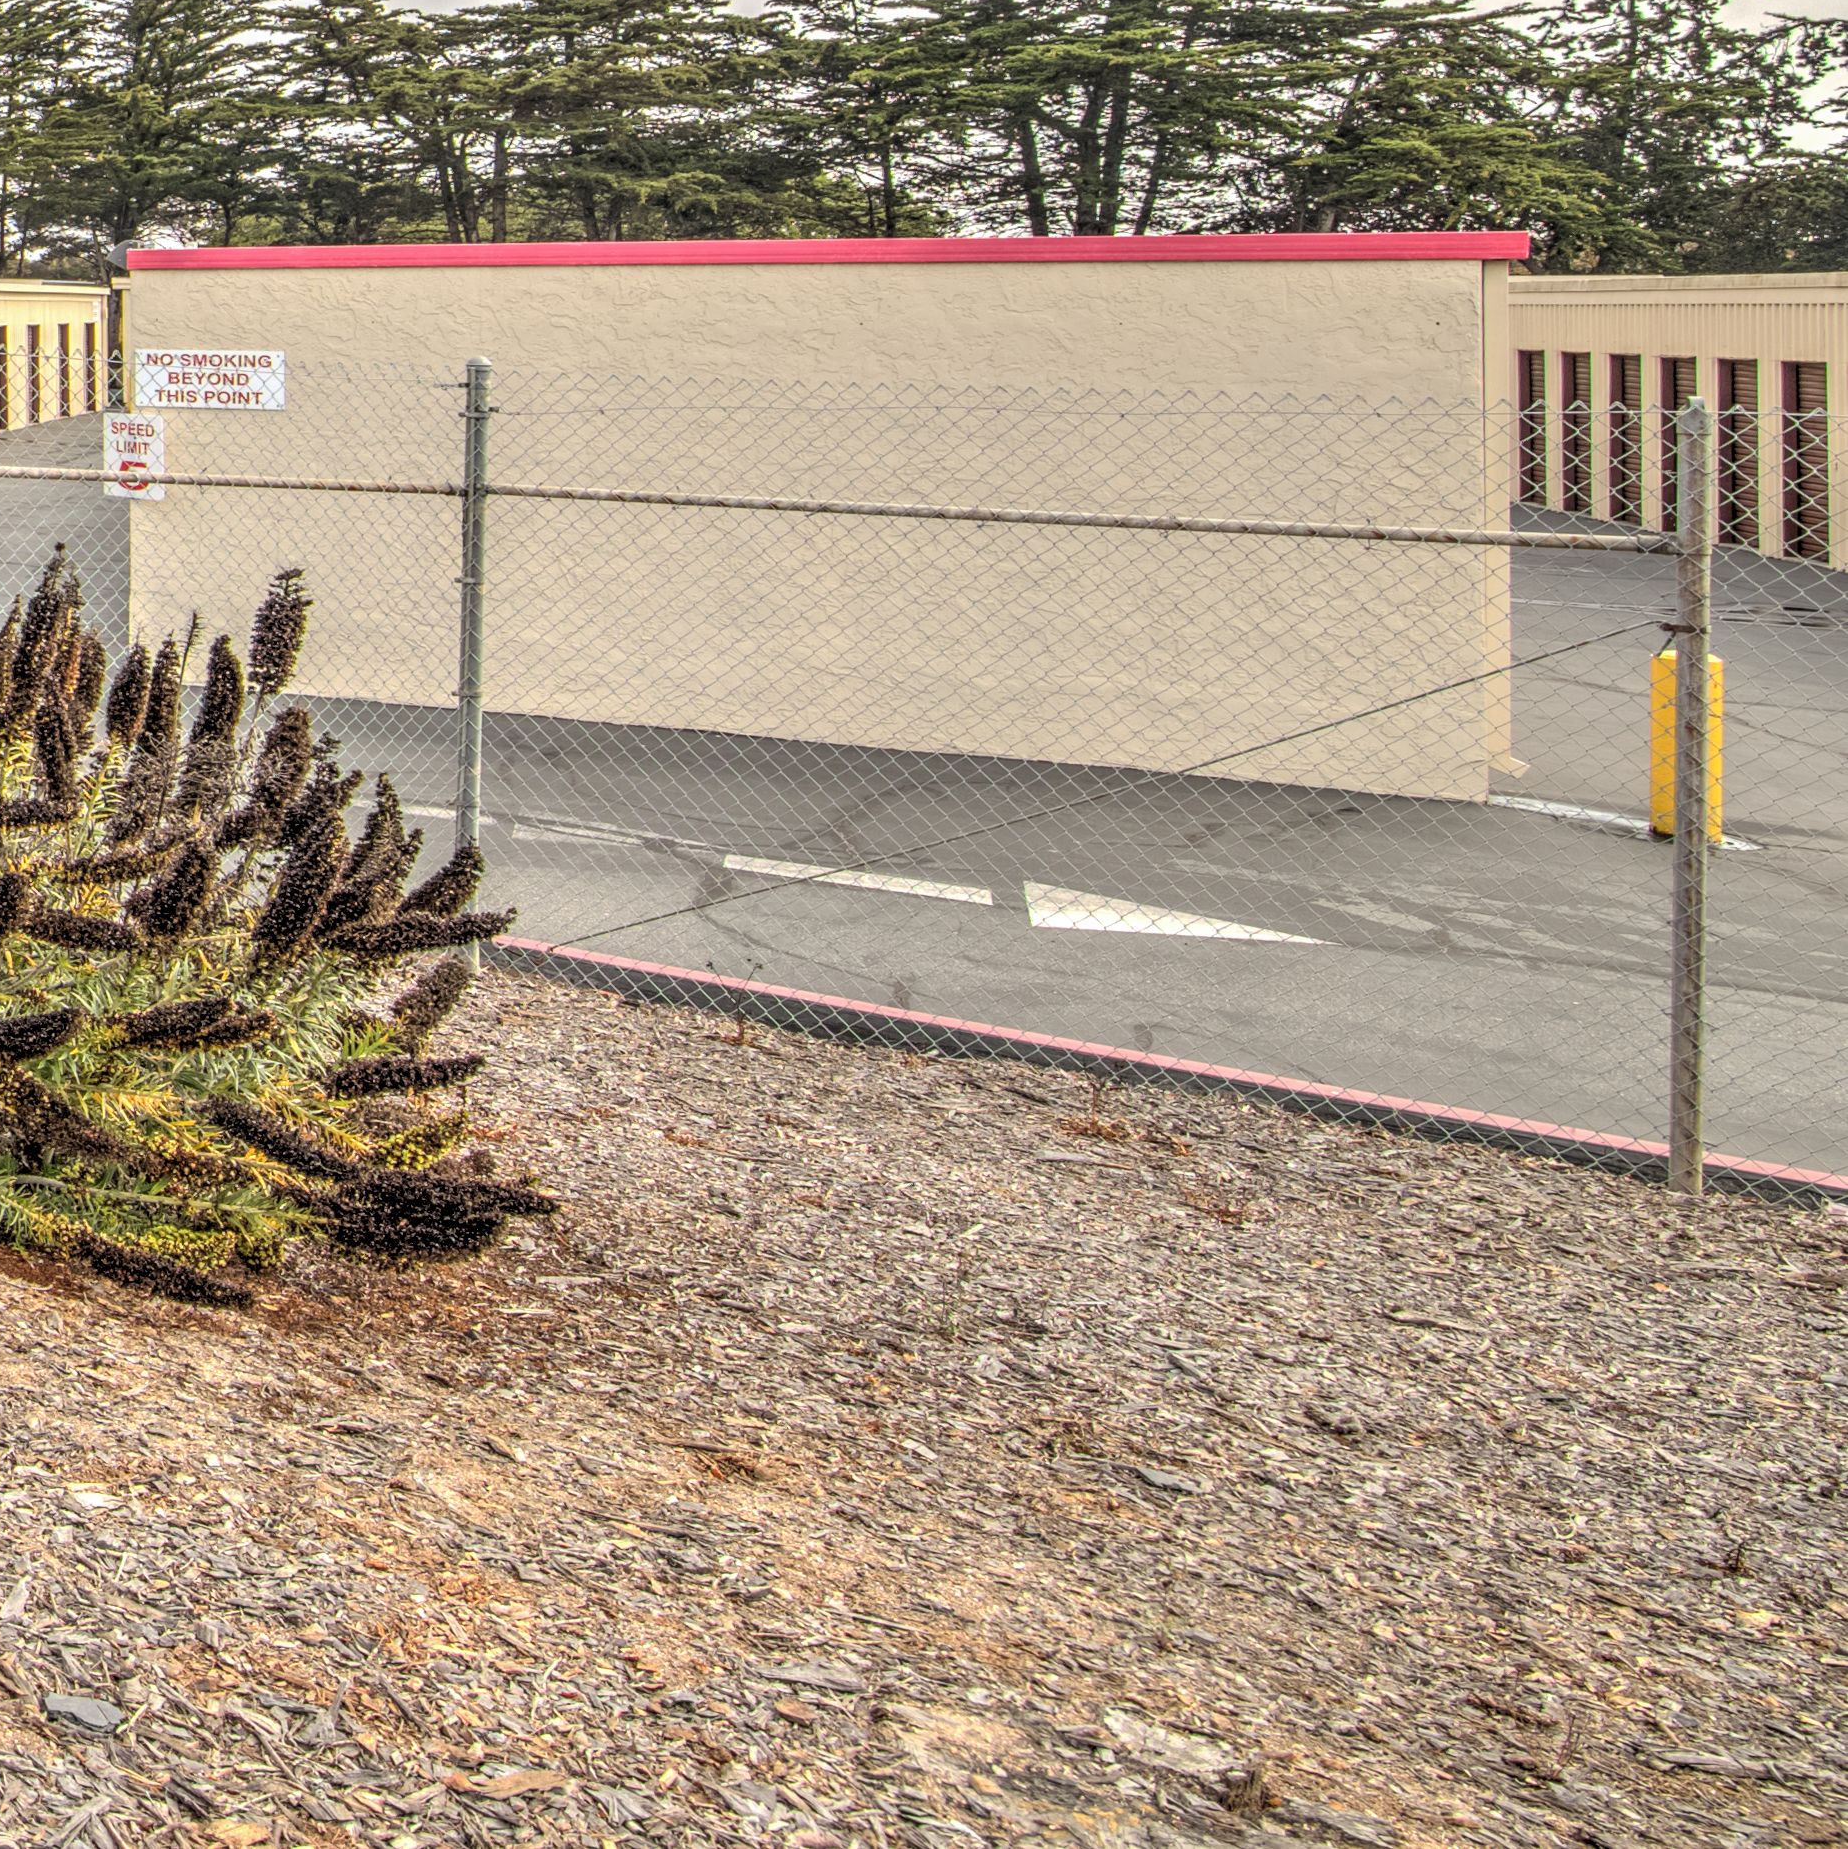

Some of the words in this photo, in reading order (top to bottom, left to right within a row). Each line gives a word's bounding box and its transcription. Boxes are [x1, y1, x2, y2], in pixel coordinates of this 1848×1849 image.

[147, 353, 173, 366] NO
[180, 353, 272, 368] SMOKING
[168, 372, 249, 386] BEYOND
[156, 390, 197, 403] THIS
[205, 390, 263, 404] POINT
[111, 422, 155, 437] SPEED
[116, 440, 150, 455] LIMIT
[118, 460, 149, 491] 5
